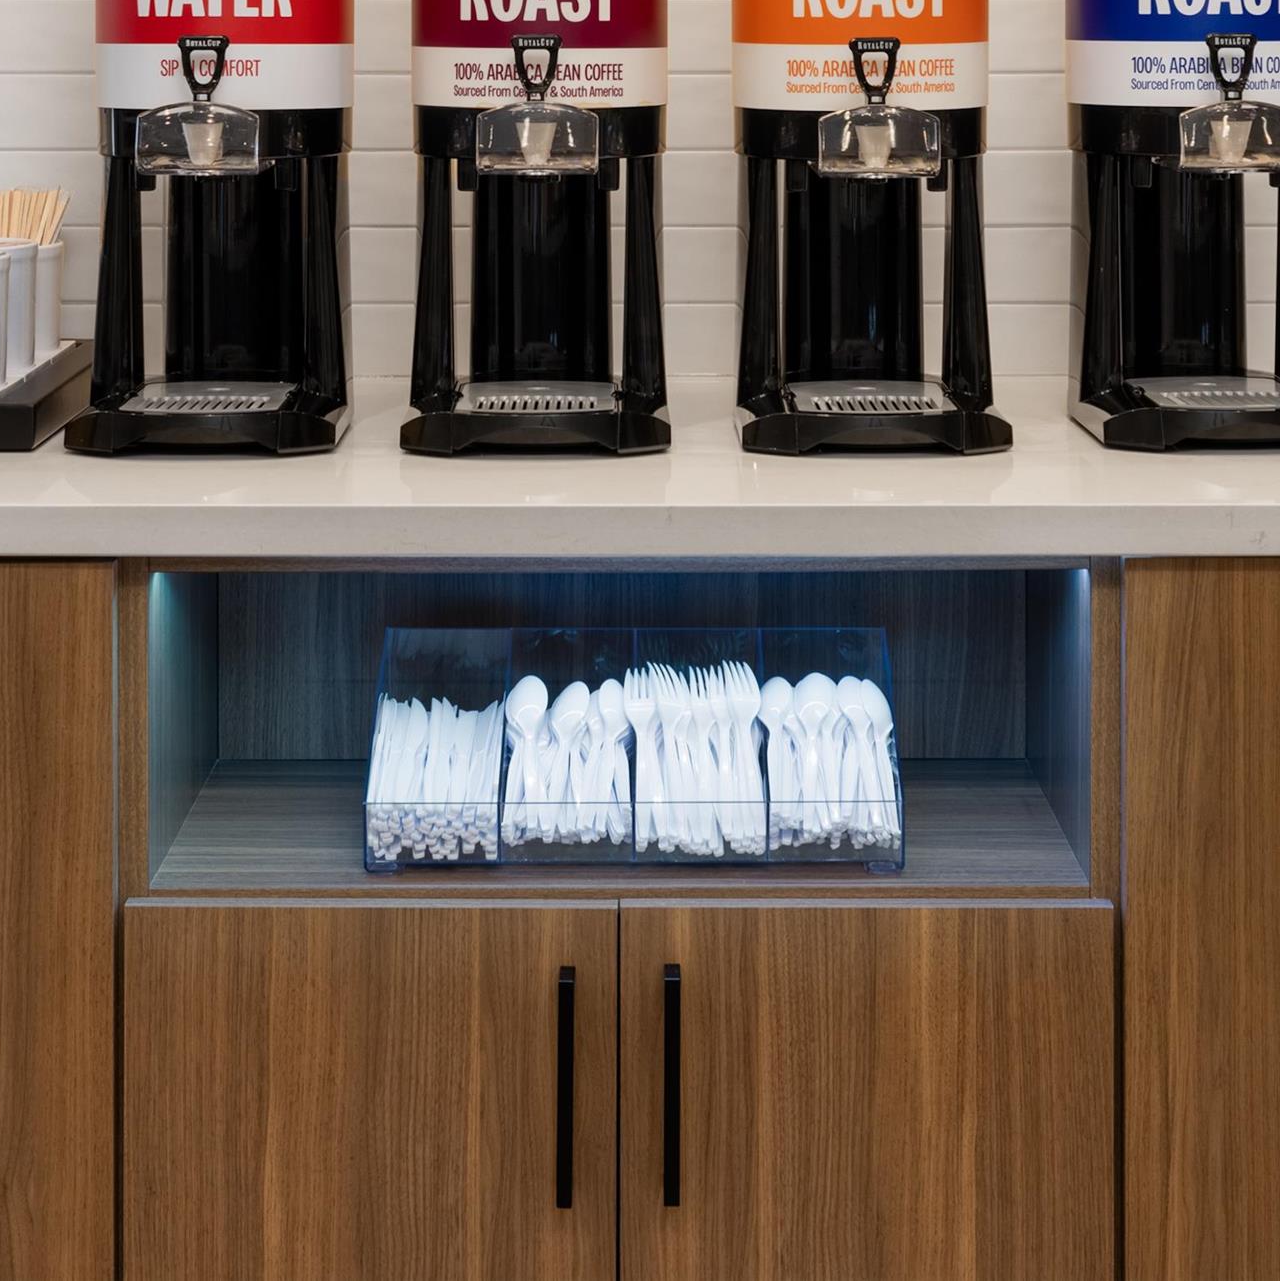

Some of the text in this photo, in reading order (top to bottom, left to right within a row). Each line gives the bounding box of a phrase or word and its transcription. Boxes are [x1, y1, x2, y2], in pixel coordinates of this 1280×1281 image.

[160, 59, 179, 77] SIP
[454, 63, 623, 81] 100% ARABCA EAN COFFEE
[786, 60, 818, 77] 100%
[822, 60, 879, 77] ARABCA
[919, 59, 955, 76] COFFEE
[1131, 57, 1165, 74] 100%
[1169, 57, 1227, 74] ARABIA
[454, 85, 486, 98] Sourced
[488, 85, 511, 98] From
[549, 85, 558, 98] &
[560, 85, 587, 98] South
[589, 85, 623, 98] America
[786, 81, 820, 94] Sourced
[823, 82, 846, 94] From
[896, 82, 922, 94] South
[923, 80, 955, 94] America
[1131, 78, 1168, 91] Sourced
[1171, 78, 1195, 91] From
[1245, 78, 1269, 91] South
